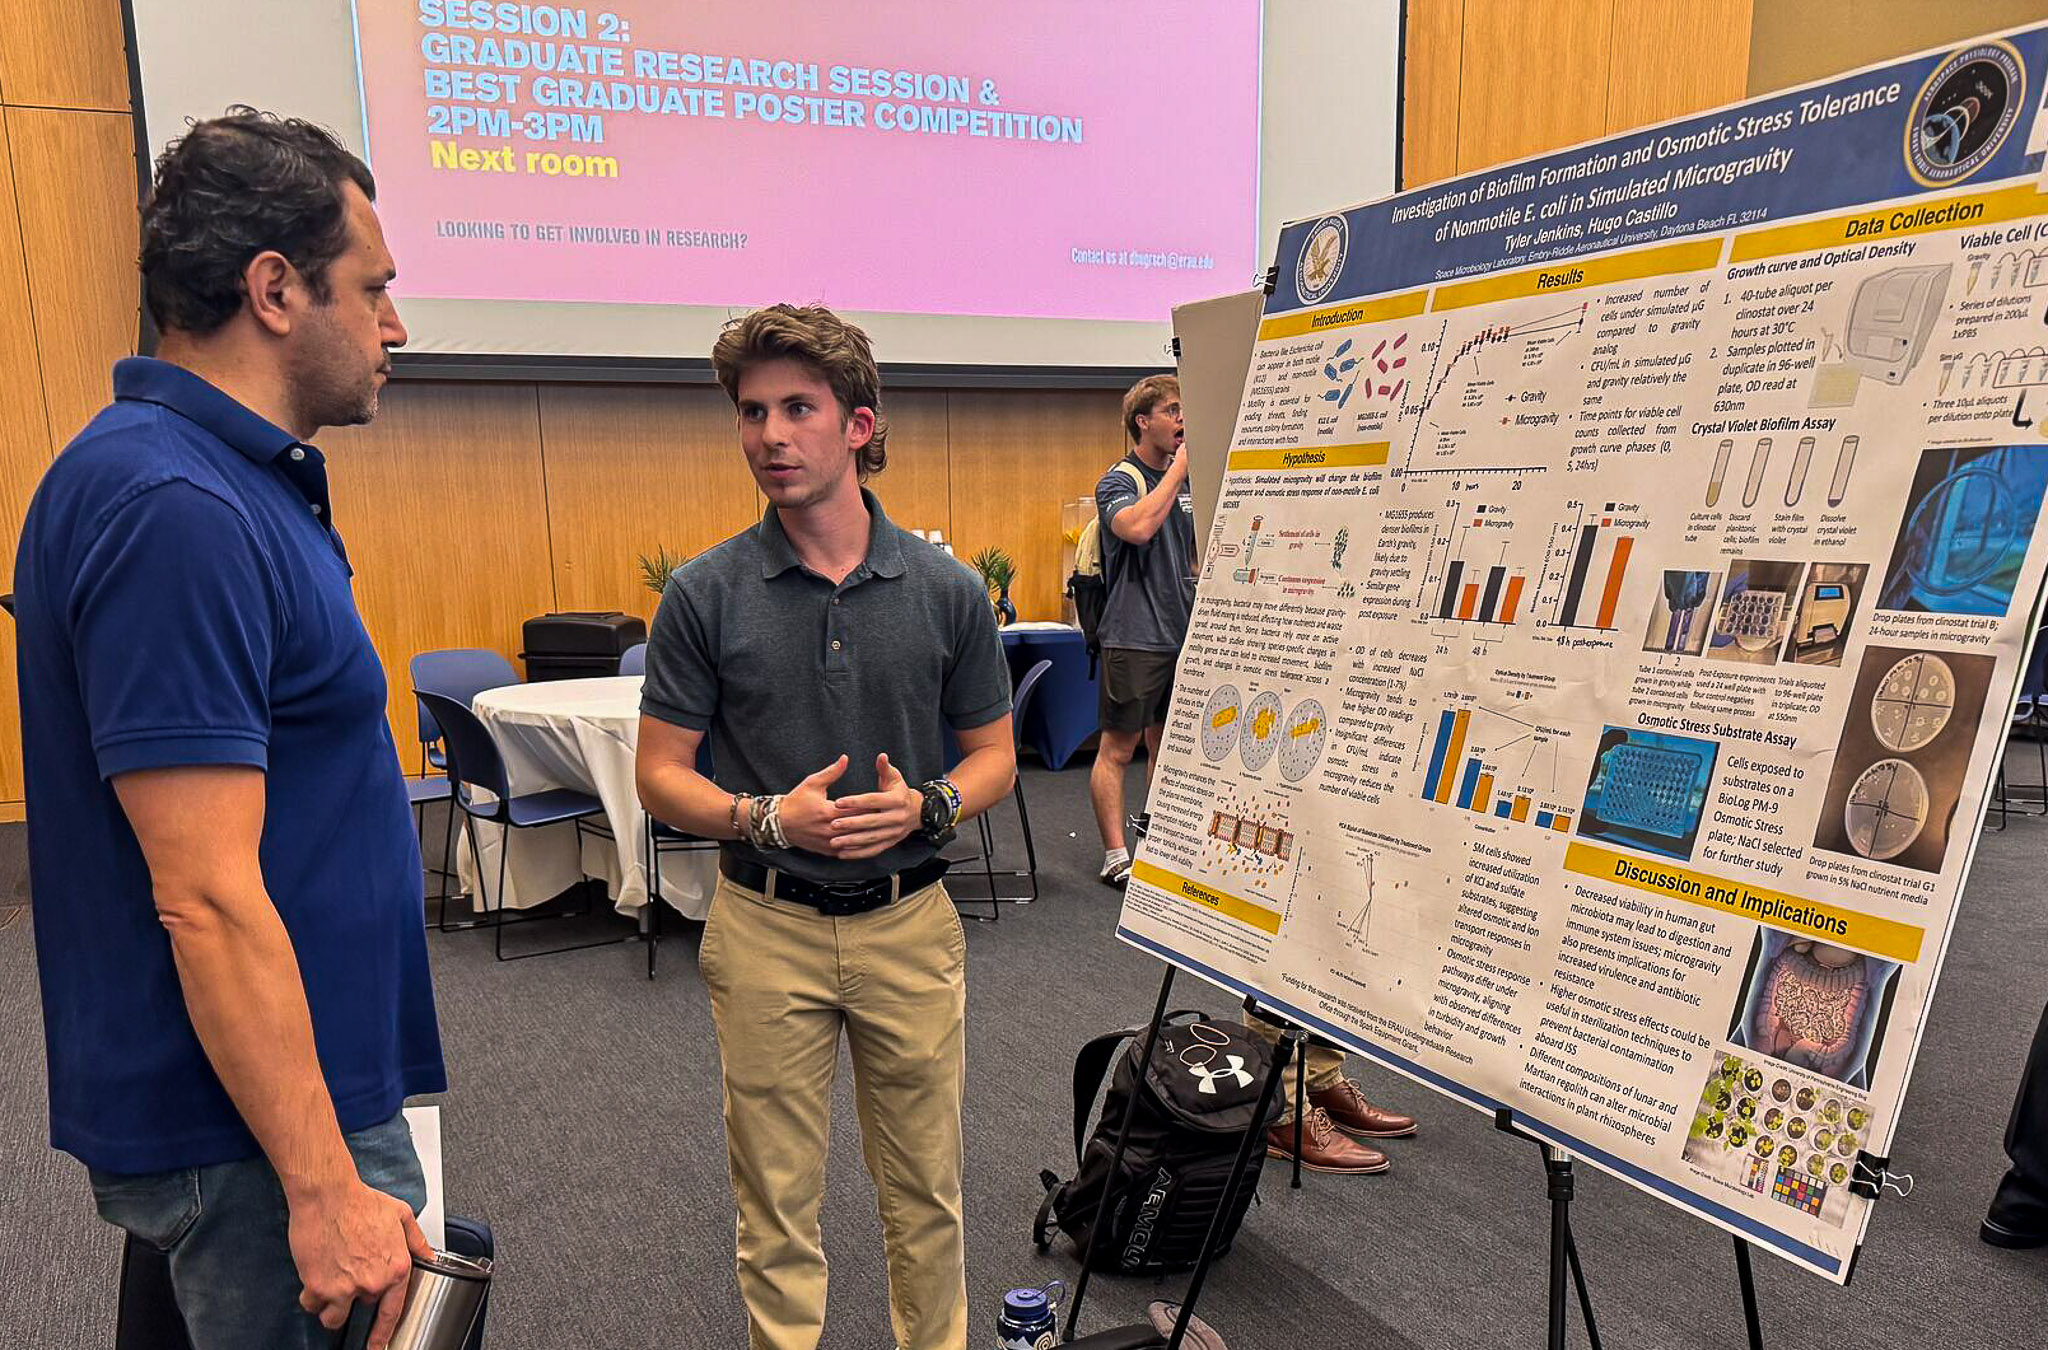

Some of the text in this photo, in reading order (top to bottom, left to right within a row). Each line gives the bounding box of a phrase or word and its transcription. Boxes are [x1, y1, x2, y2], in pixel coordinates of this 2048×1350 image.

[419, 0, 630, 42] SESSION 2:
[422, 32, 999, 105] GRADUATE RESEARCH SESSION &
[424, 69, 1083, 144] BEST GRADUATE POSTER COMPETITION
[428, 105, 604, 143] 2PM-3PM
[430, 141, 619, 177] Next room
[1392, 82, 1901, 224] Investigation of Biofilm Formation and Osmotic Stress Tolerance
[1435, 146, 1794, 242] of Nonmotile E. coli in Simulated Microgravity
[1504, 203, 1678, 253] Tyler Jenkins, Hugo Castillo
[1845, 202, 1984, 239] Data Collection
[437, 221, 749, 250] LOOKING TO GET INVOLVED IN RESEARCH?
[1435, 267, 1454, 281] Space
[1455, 260, 1493, 278] Microbiology
[1528, 244, 1573, 263] Embry-Riddle
[1575, 237, 1619, 254] Aeronautical
[1660, 221, 1695, 239] Daytona
[1697, 215, 1725, 231] Beach
[1726, 213, 1738, 226] FL
[1741, 207, 1768, 225] 32114
[1960, 231, 2003, 250] Viable
[2006, 224, 2032, 243] Cell
[1072, 248, 1104, 264] Contact
[1106, 252, 1116, 264] us
[1118, 251, 1128, 265] at
[1727, 240, 1915, 281] Growth curve and Optical Density
[1537, 269, 1584, 290] Results
[1605, 280, 1711, 305] Increased number of
[1724, 281, 1834, 304] 1. 40-tube aliquot per
[1311, 309, 1364, 328] Introduction
[1735, 300, 1814, 320] clinostat over 24
[1731, 326, 1758, 339] hours
[1760, 325, 1770, 336] at
[1709, 337, 1815, 359] 2. Samples plotted in
[1722, 355, 1816, 377] duplicate in 96-well
[1717, 377, 1797, 397] plate, OD read at
[1713, 400, 1745, 413] 630nm
[1514, 412, 1560, 427] Microgravity
[1691, 415, 1836, 437] Crystal Violet Biofilm Assay
[1282, 451, 1326, 468] Hypothesis
[1817, 526, 1857, 535] crystal violet
[1820, 514, 1847, 523] Dissolve
[1637, 713, 1798, 750] Osmotic Stress Substrate Assay
[1727, 755, 1805, 780] Cells exposed to
[1722, 775, 1795, 797] substrates on a
[1751, 799, 1778, 813] PM-9
[1713, 810, 1784, 835] Osmotic Stress
[1707, 829, 1803, 859] plate; NaCl selected
[1703, 846, 1783, 877] for further study
[1809, 856, 1935, 893] Drop plates from clinostat trial G1
[1182, 881, 1220, 906] References
[1614, 859, 1848, 937] Discussion and Implications
[1574, 884, 1716, 934] Decreased viability in human gut
[1570, 902, 1732, 958] microbiota may lead to digestion and
[1519, 1078, 1656, 1146] interactions in plant rhizospheres
